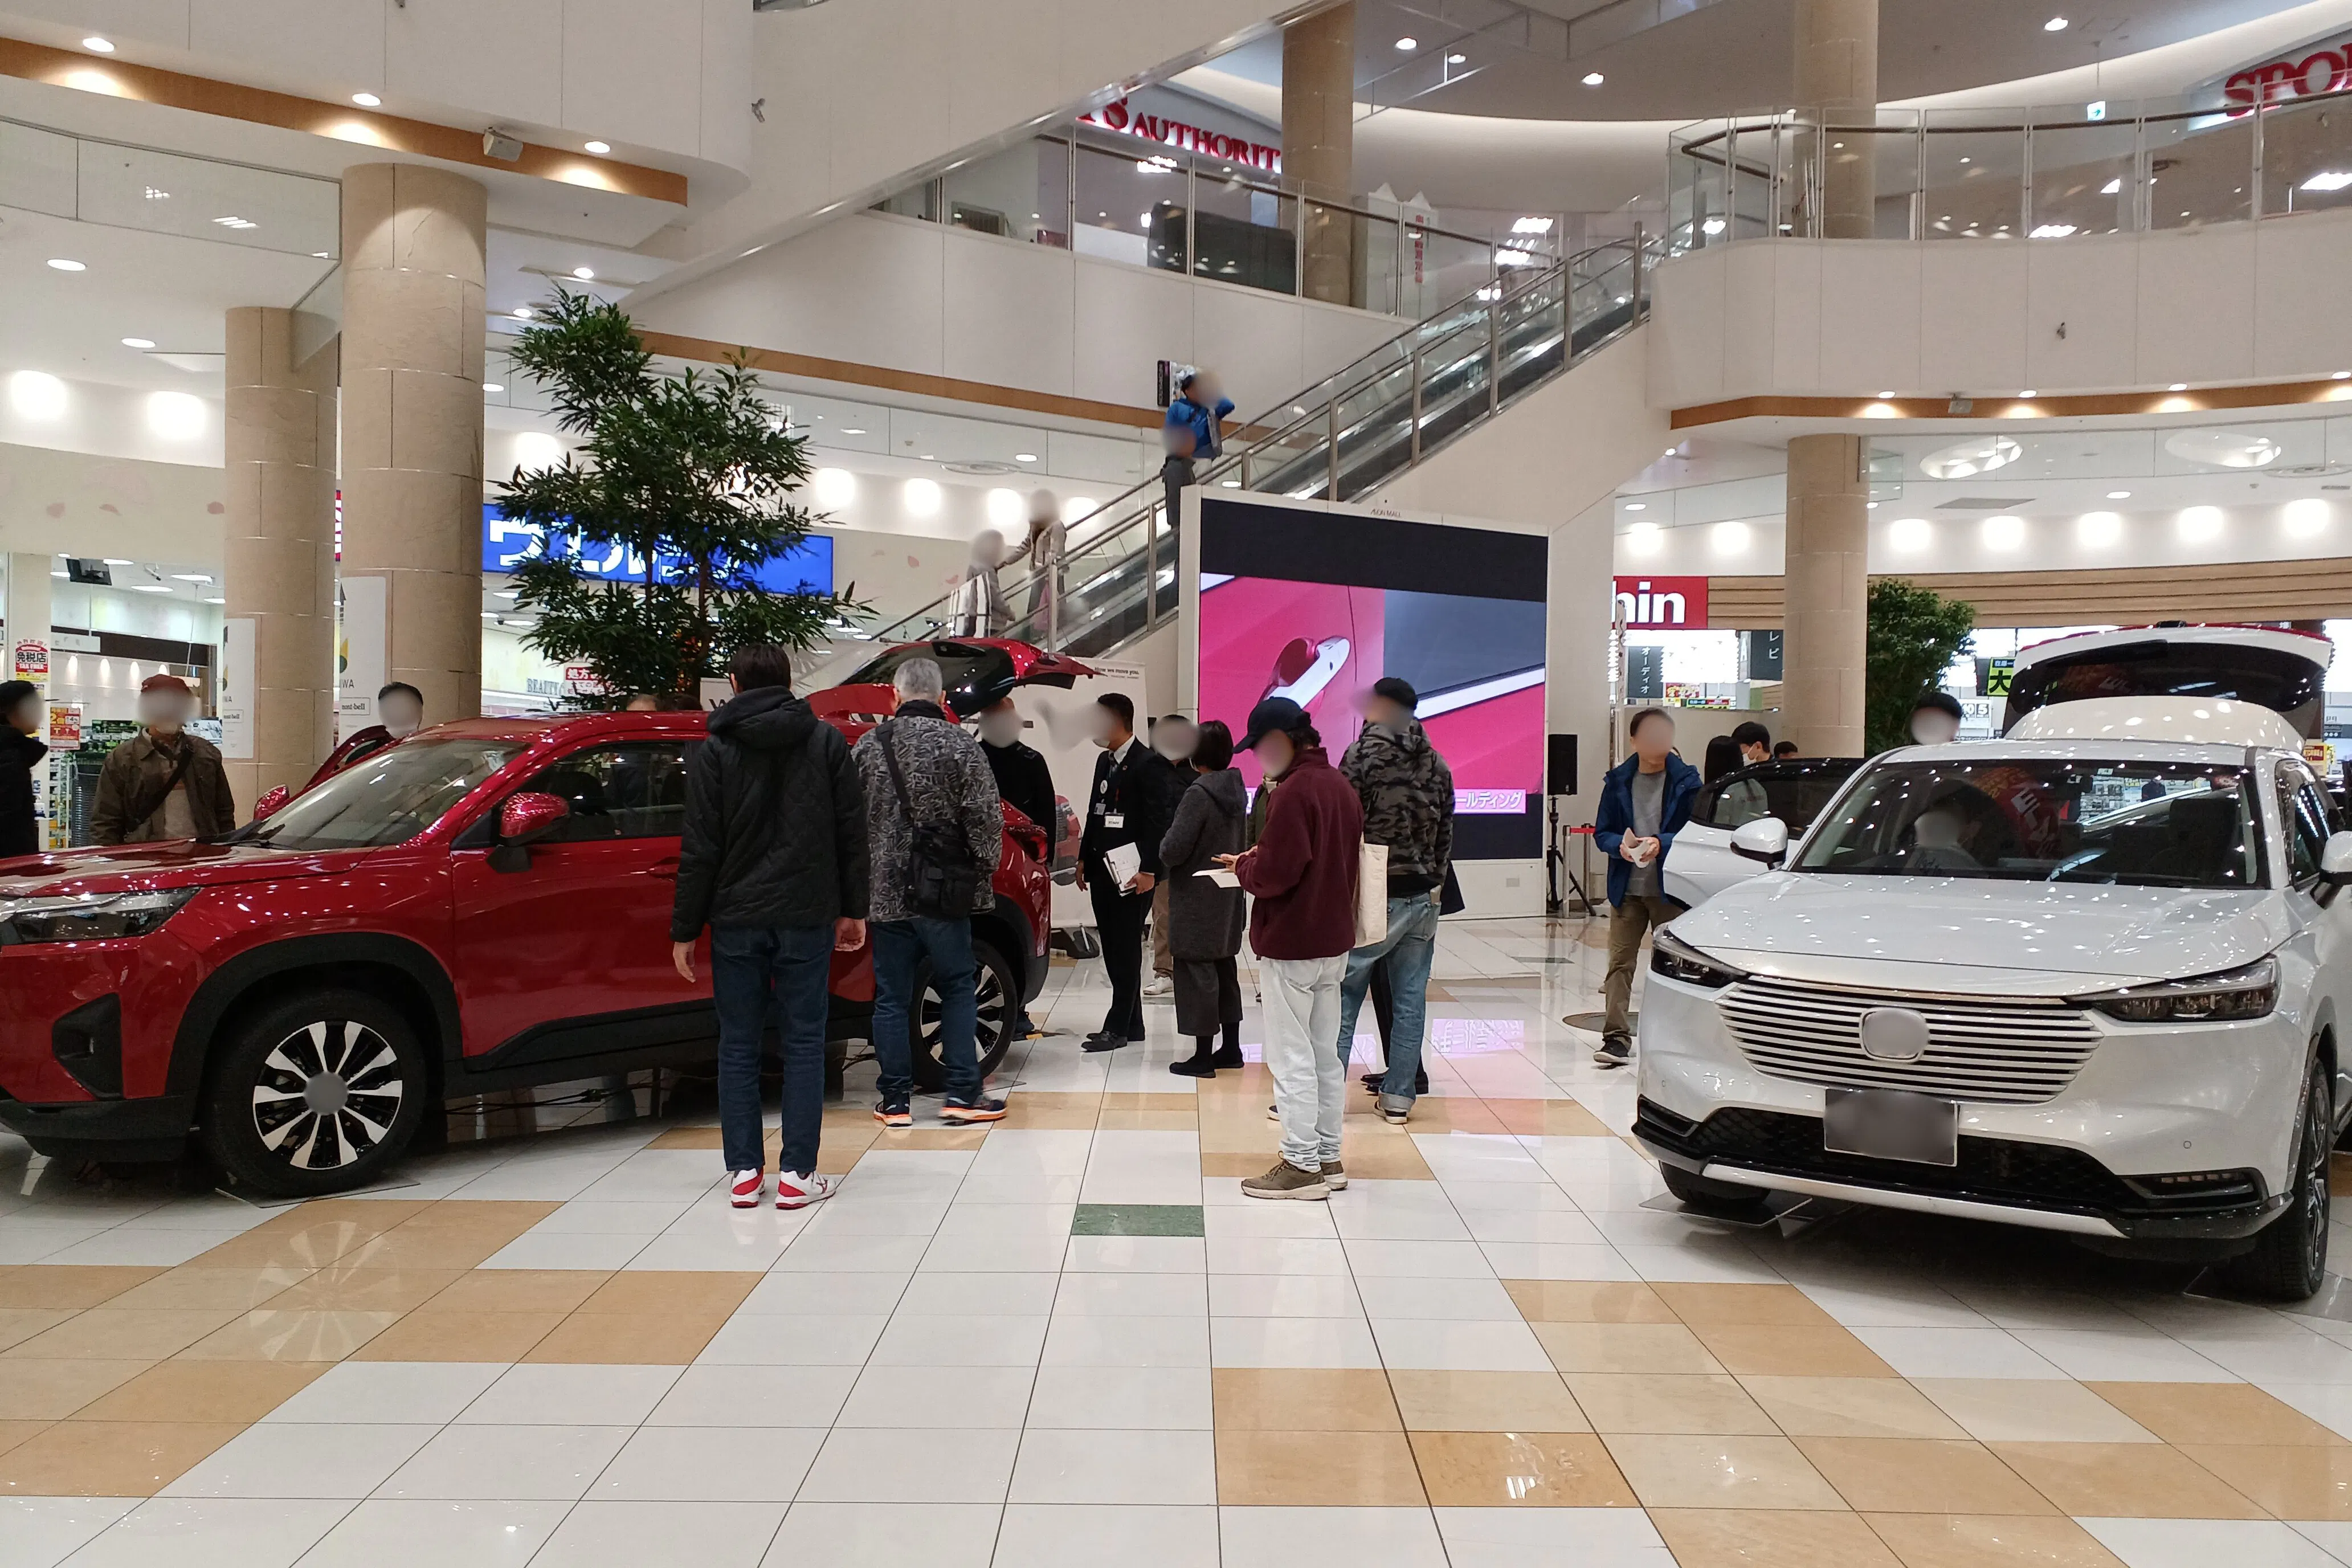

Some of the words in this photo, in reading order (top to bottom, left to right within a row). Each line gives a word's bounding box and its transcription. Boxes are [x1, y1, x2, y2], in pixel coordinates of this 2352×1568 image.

[18, 652, 46, 663] 免税店
[1641, 647, 1651, 693] オーディオ
[1989, 670, 2011, 693] 大
[1455, 791, 1522, 808] ールディング
